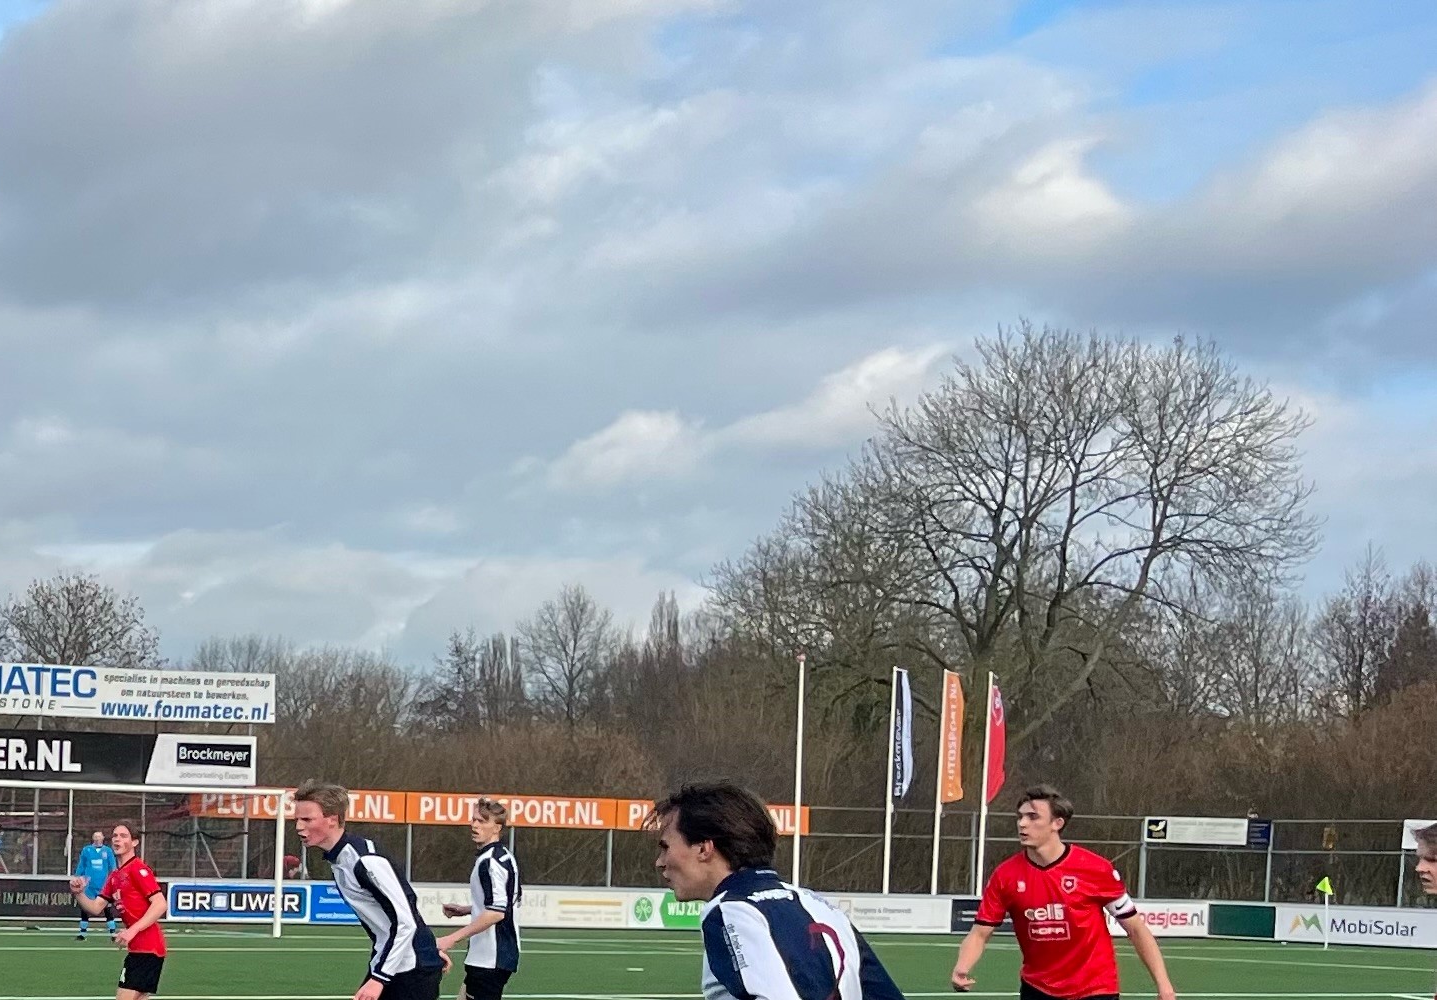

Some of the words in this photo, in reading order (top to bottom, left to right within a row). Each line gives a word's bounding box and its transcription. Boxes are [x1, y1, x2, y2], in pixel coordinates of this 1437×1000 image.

[104, 673, 147, 684] specialist
[150, 674, 158, 684] in
[161, 675, 200, 686] machines
[204, 678, 213, 687] en
[216, 676, 270, 689] gereedschap
[121, 688, 133, 697] om
[136, 688, 191, 699] natuursteen
[194, 690, 203, 699] te
[101, 700, 269, 721] www.fonmatec.nl
[178, 746, 249, 764] Brockmeyer
[201, 791, 395, 820] PLUTOST.NL
[419, 795, 604, 826] PLUTPORT.NL
[667, 902, 684, 916] WIJ
[686, 902, 702, 916] ZIJ
[1330, 918, 1417, 938] MobiSolar
